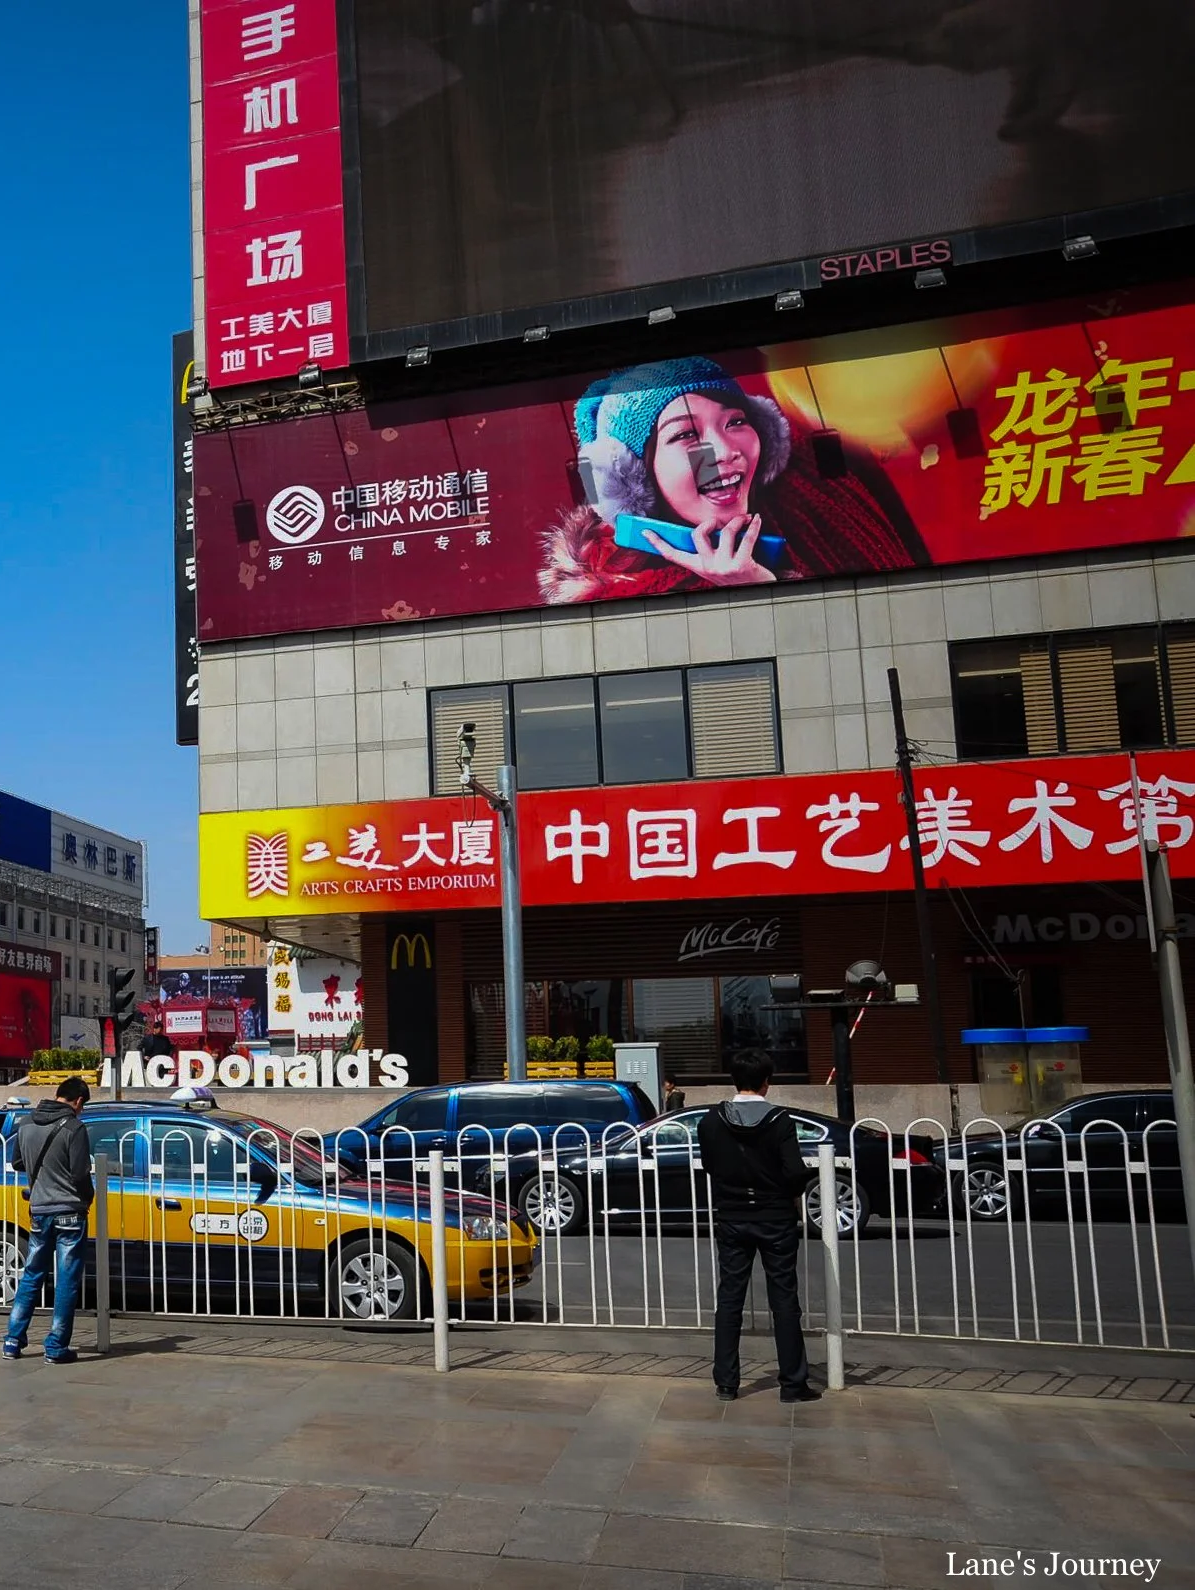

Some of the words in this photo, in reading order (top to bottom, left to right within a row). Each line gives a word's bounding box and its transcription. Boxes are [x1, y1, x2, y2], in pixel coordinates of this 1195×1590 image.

[241, 4, 303, 287] 手机广场
[820, 240, 952, 281] STAPLES
[221, 300, 333, 342] 工美大厦
[221, 332, 335, 374] 地下一层
[332, 468, 489, 509] 中国移动通信
[334, 503, 405, 532] CHINA
[409, 496, 491, 523] MOBILE
[269, 529, 492, 571] 移动信息专家
[63, 832, 136, 883] 奥林巴斯
[300, 880, 340, 896] ARTS
[343, 877, 403, 894] CRAFTS
[407, 873, 495, 892] EMPORIUM
[680, 916, 781, 958] McCafé
[308, 1012, 334, 1022] DONG
[338, 1012, 352, 1022] LAI
[101, 1048, 409, 1087] McDonald's
